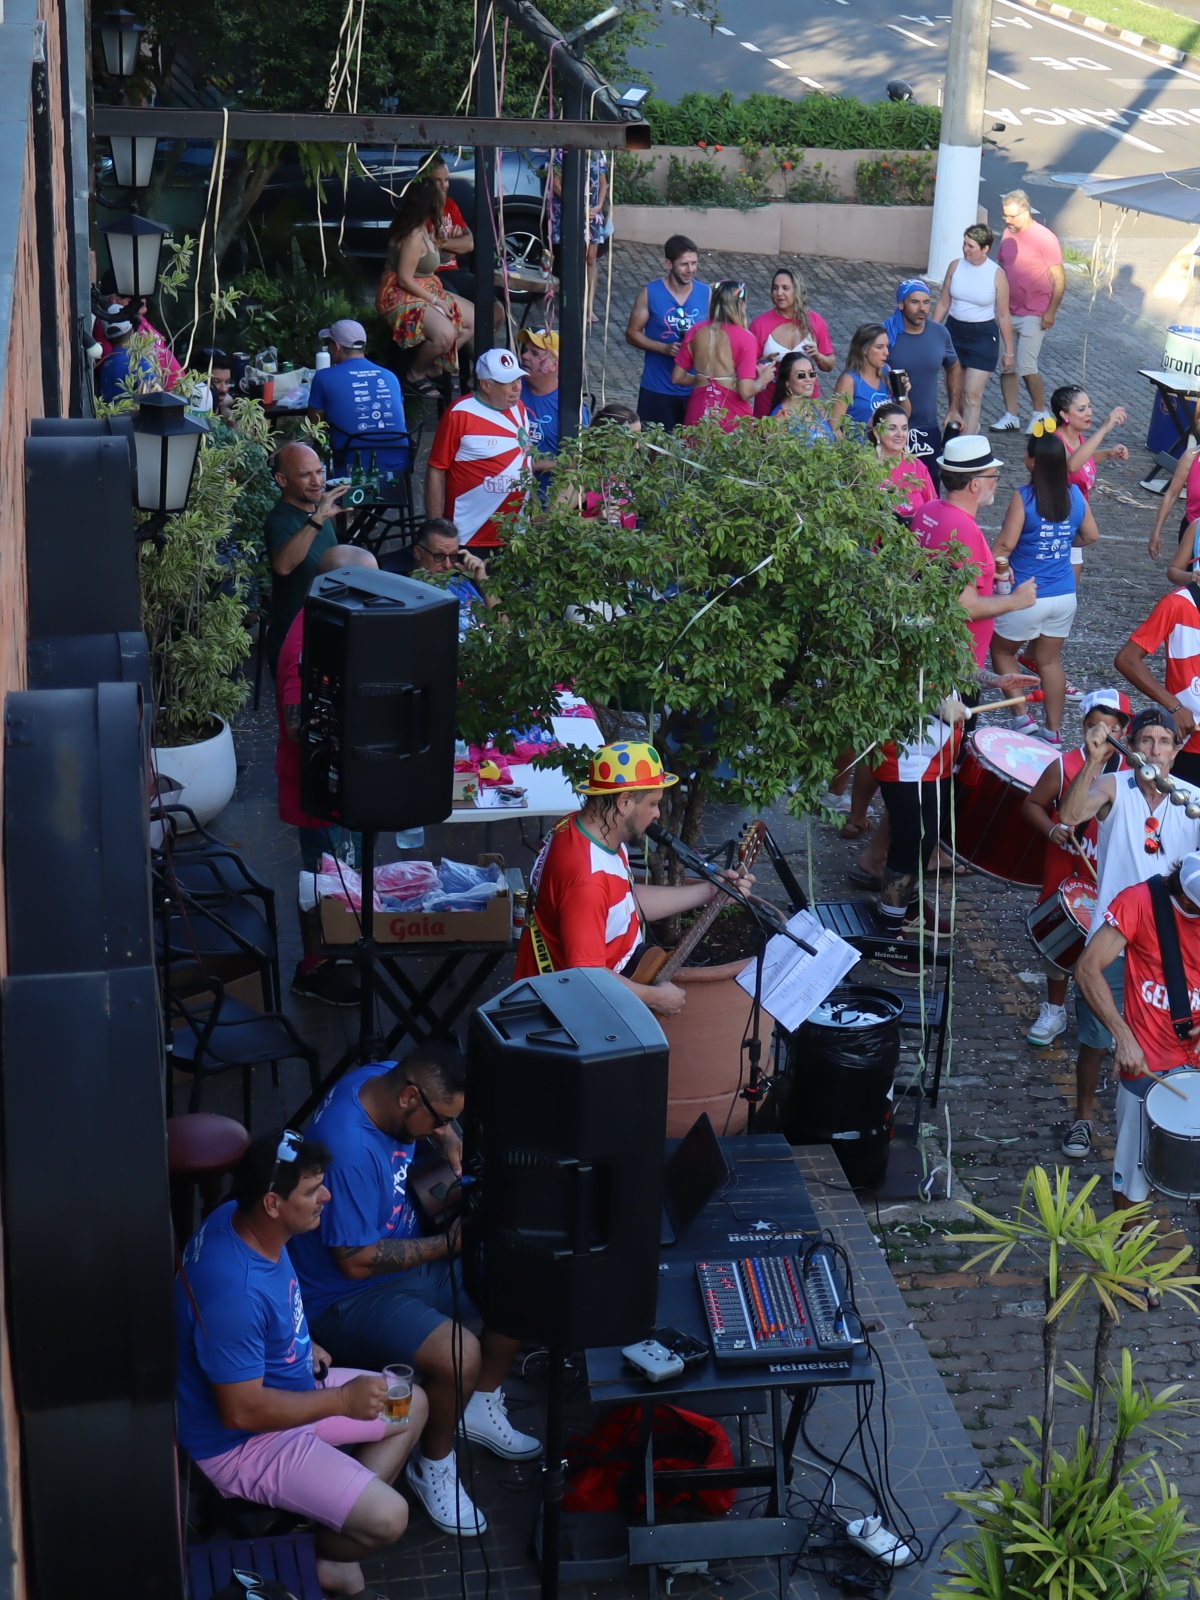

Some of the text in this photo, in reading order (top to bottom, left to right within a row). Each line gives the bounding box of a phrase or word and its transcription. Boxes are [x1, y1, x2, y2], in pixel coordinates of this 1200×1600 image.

[1029, 56, 1113, 71] DE
[389, 917, 447, 941] Gaia
[874, 951, 908, 960] Heineken
[819, 1003, 849, 1017] LIXO
[728, 1231, 803, 1243] Heineken
[769, 1361, 850, 1373] Heineken
